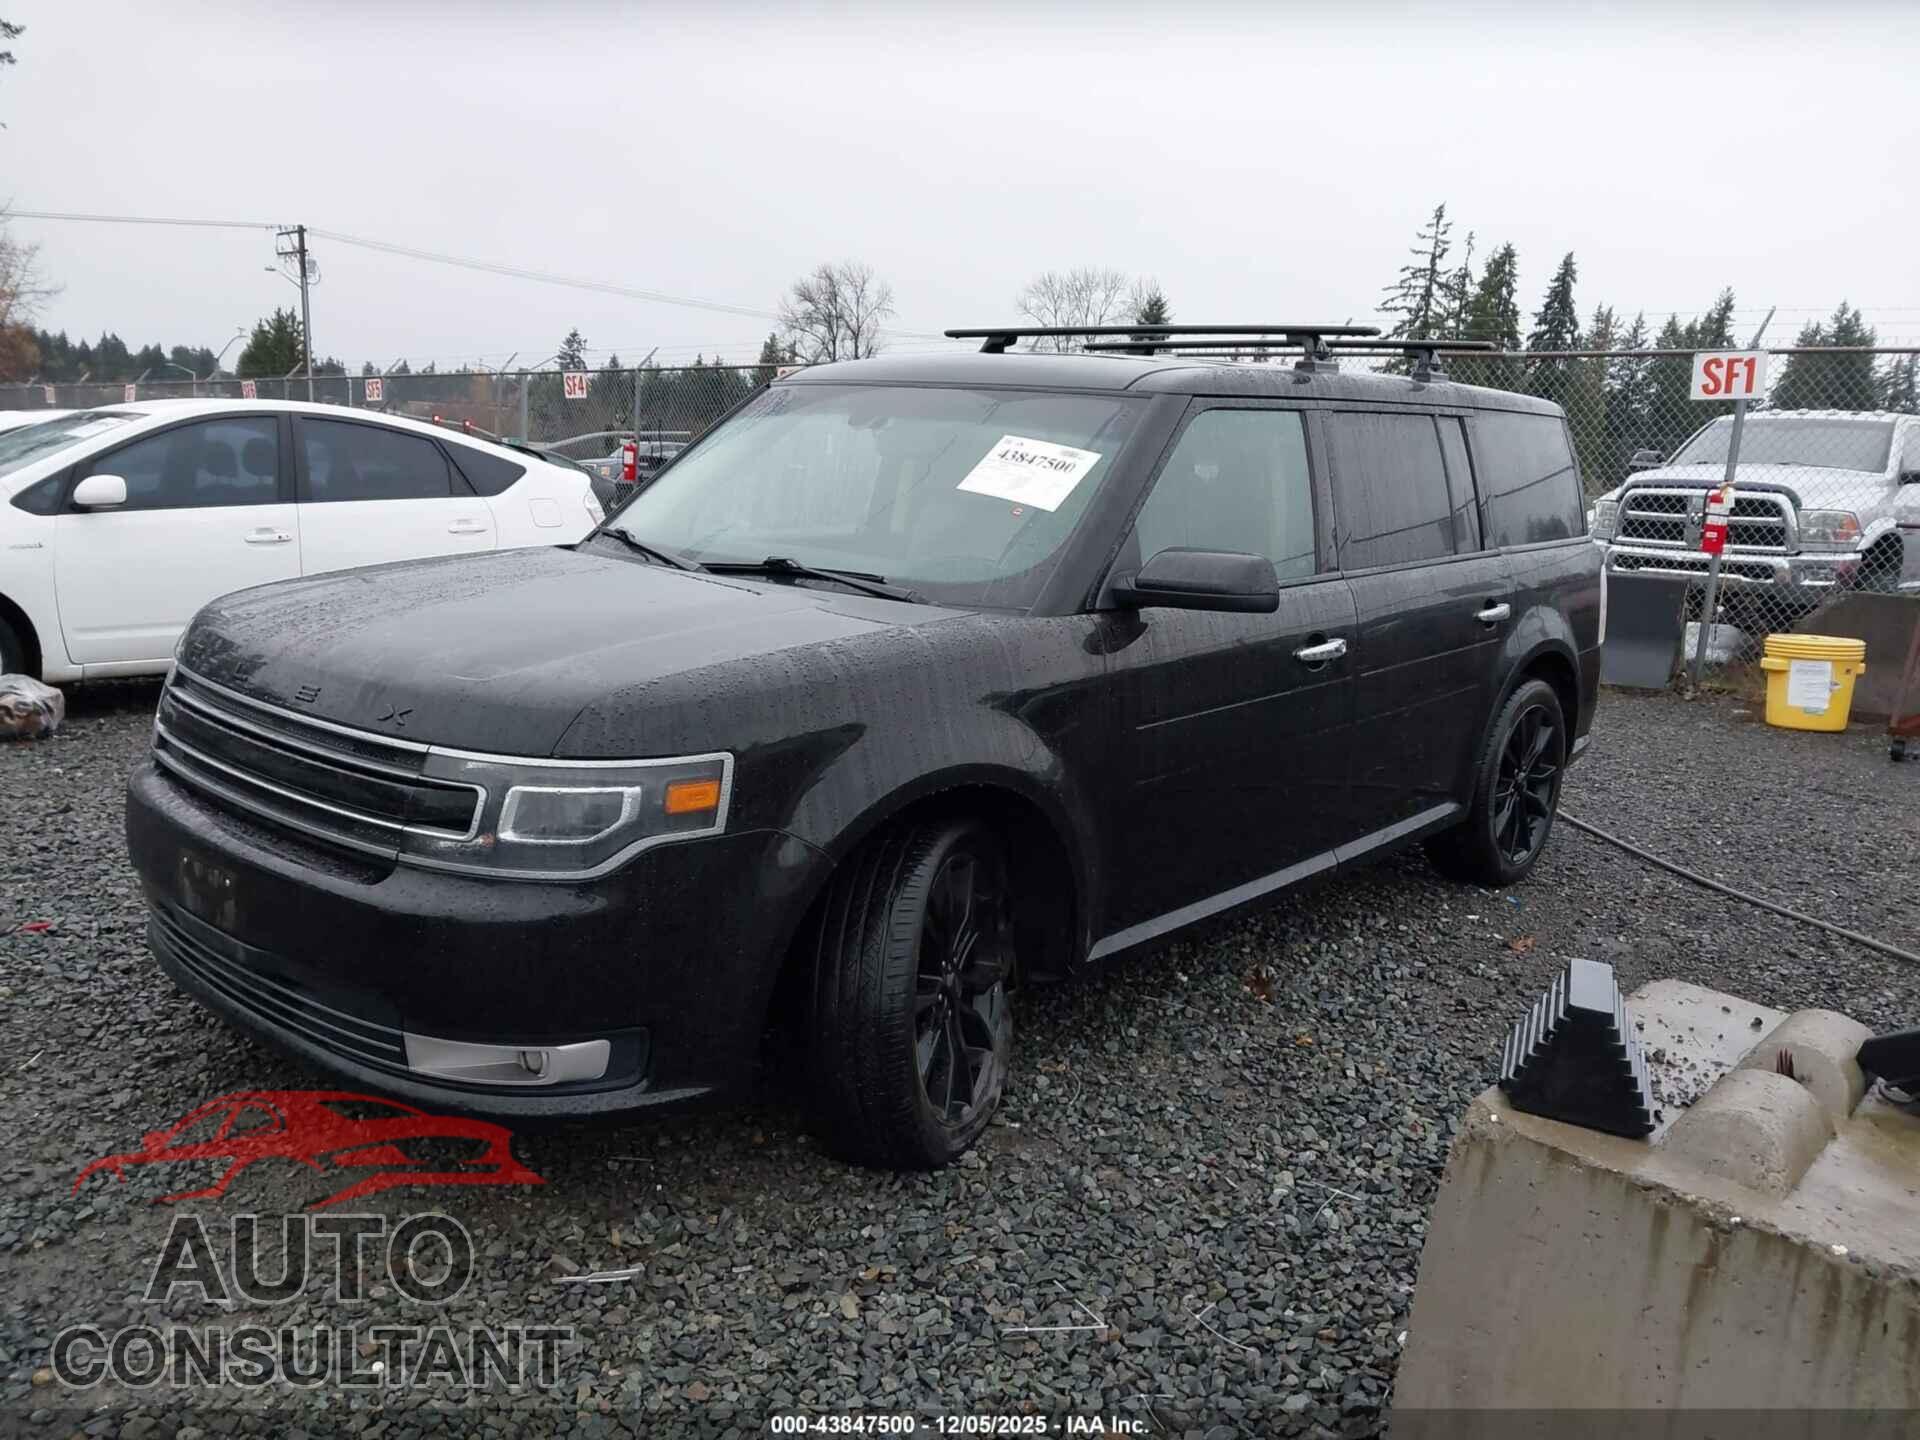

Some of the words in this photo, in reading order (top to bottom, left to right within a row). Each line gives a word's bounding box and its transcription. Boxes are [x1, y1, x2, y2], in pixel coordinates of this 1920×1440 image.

[565, 375, 585, 396] SF4
[1701, 357, 1756, 395] SF1
[997, 449, 1077, 473] 43847500
[190, 639, 415, 727] LEX
